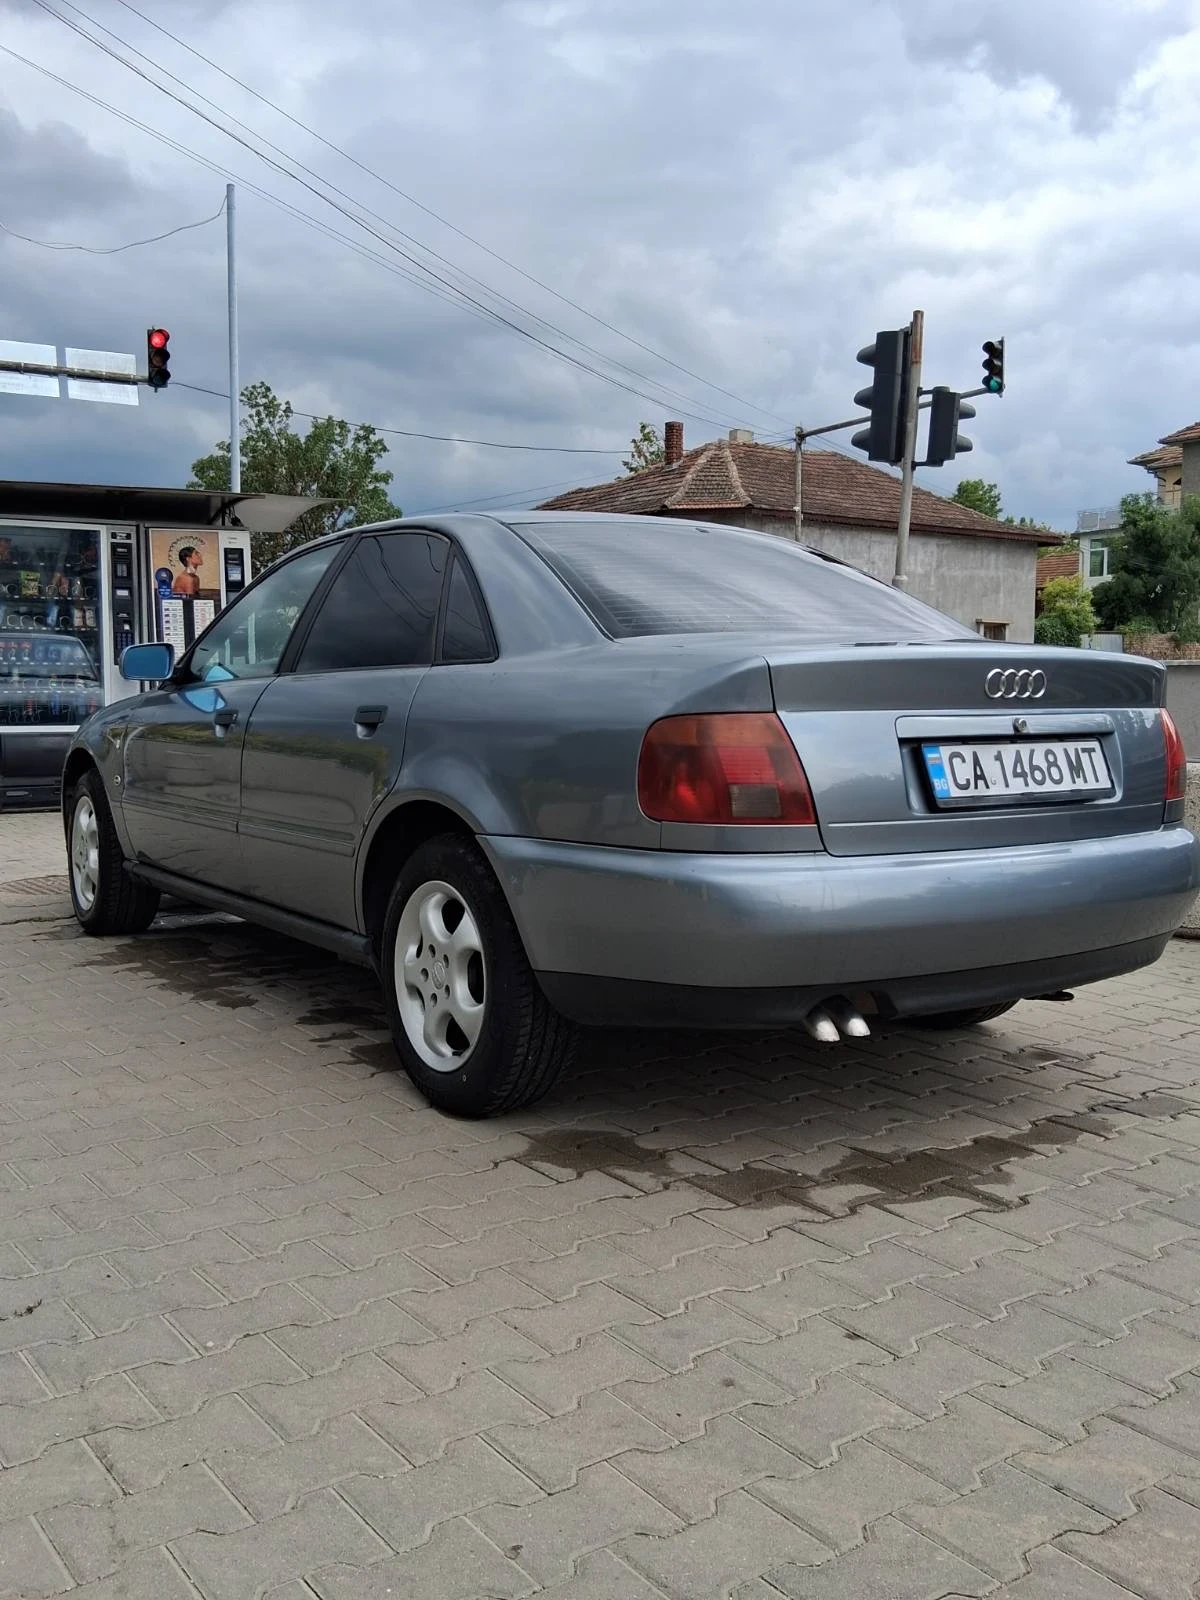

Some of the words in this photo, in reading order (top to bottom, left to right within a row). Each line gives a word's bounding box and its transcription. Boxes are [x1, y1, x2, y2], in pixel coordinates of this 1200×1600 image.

[950, 751, 990, 790] CA
[994, 749, 1064, 788] 1468
[1064, 747, 1100, 784] MT
[934, 779, 948, 790] BG
